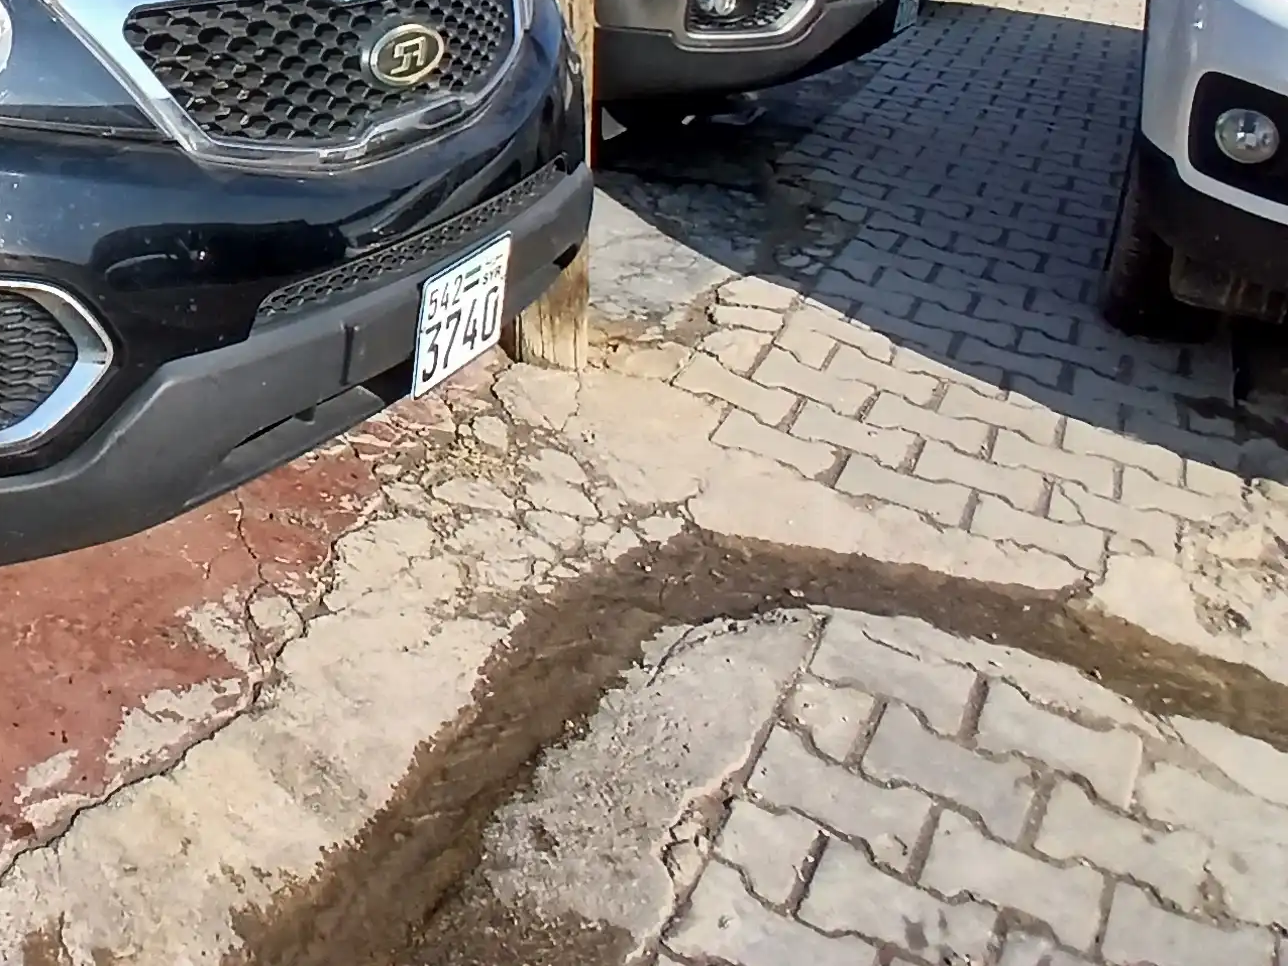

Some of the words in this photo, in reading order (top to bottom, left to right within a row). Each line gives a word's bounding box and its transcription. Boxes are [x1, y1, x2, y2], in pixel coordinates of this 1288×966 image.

[427, 274, 463, 320] 542
[482, 265, 502, 285] SYR
[422, 285, 500, 382] 3740
